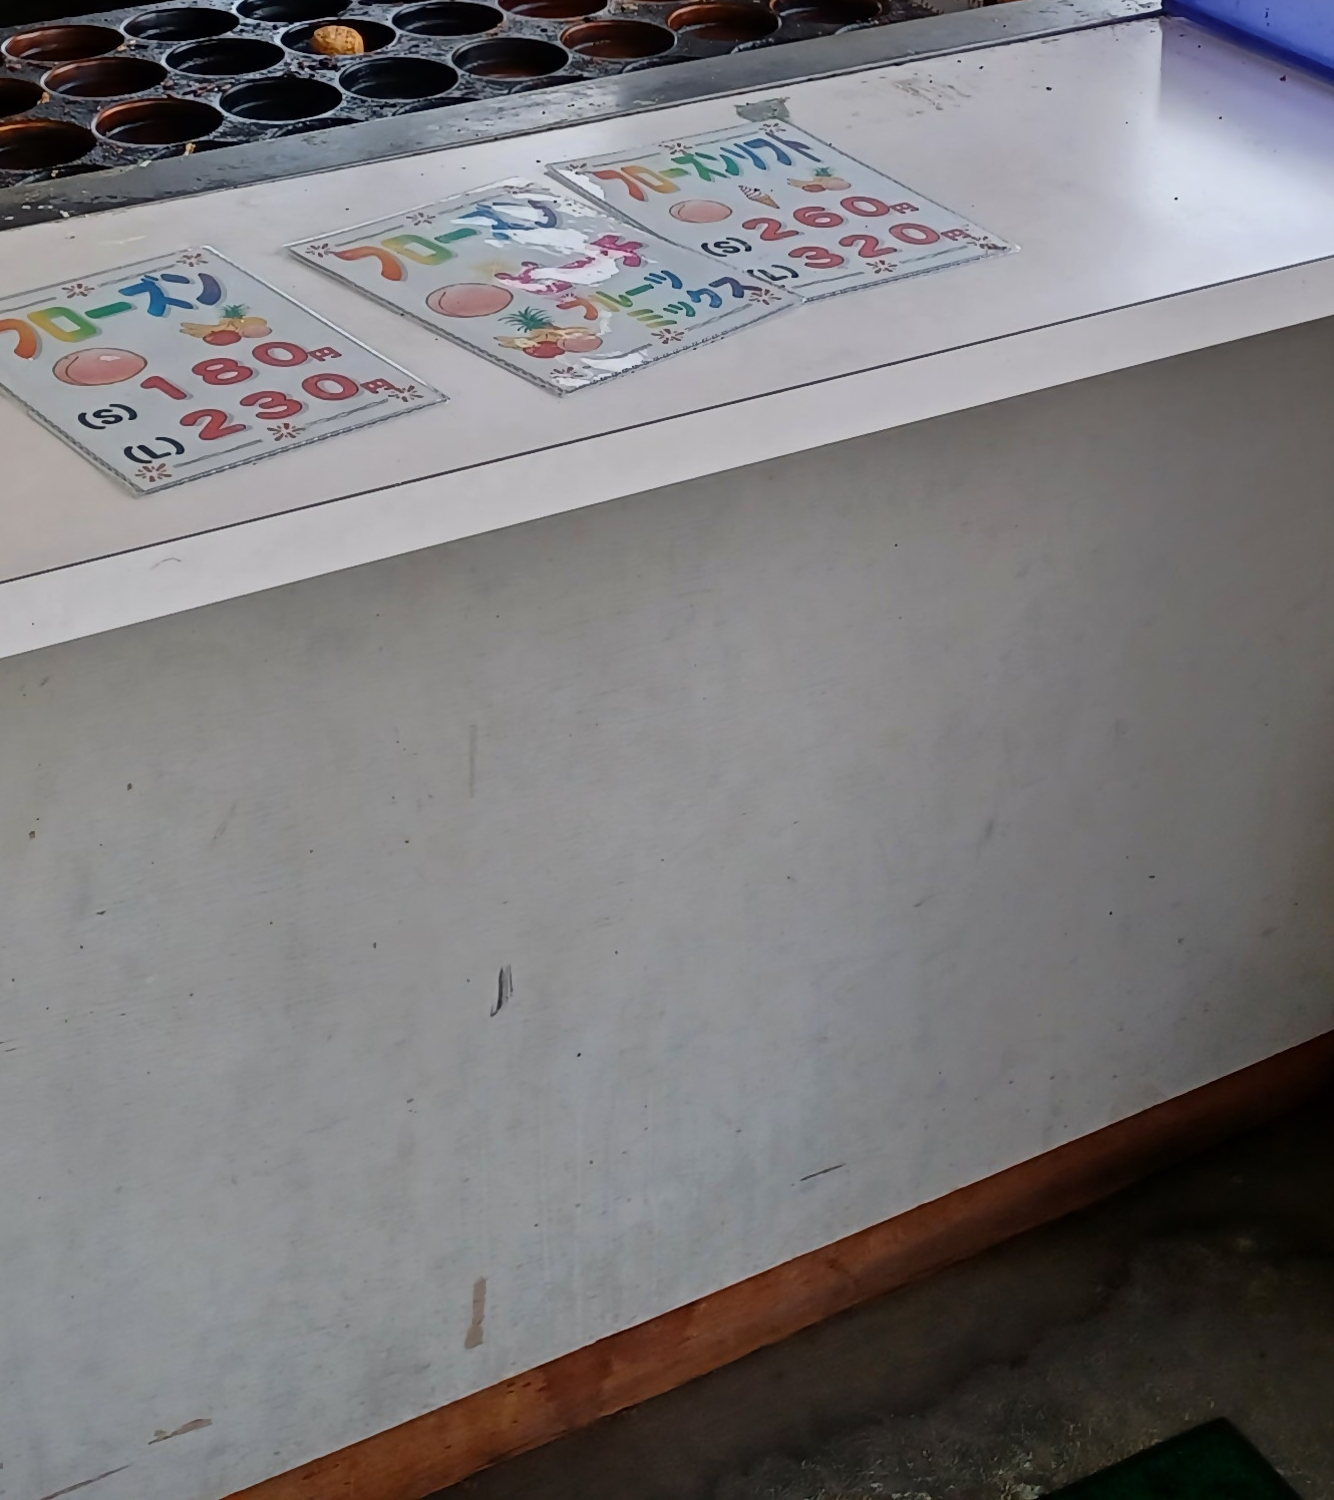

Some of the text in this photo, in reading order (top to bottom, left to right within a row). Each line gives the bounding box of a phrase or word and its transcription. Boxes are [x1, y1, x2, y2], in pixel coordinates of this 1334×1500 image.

[591, 132, 822, 202] フローズンソフト
[77, 403, 138, 430] (S)
[123, 436, 185, 464] (L)
